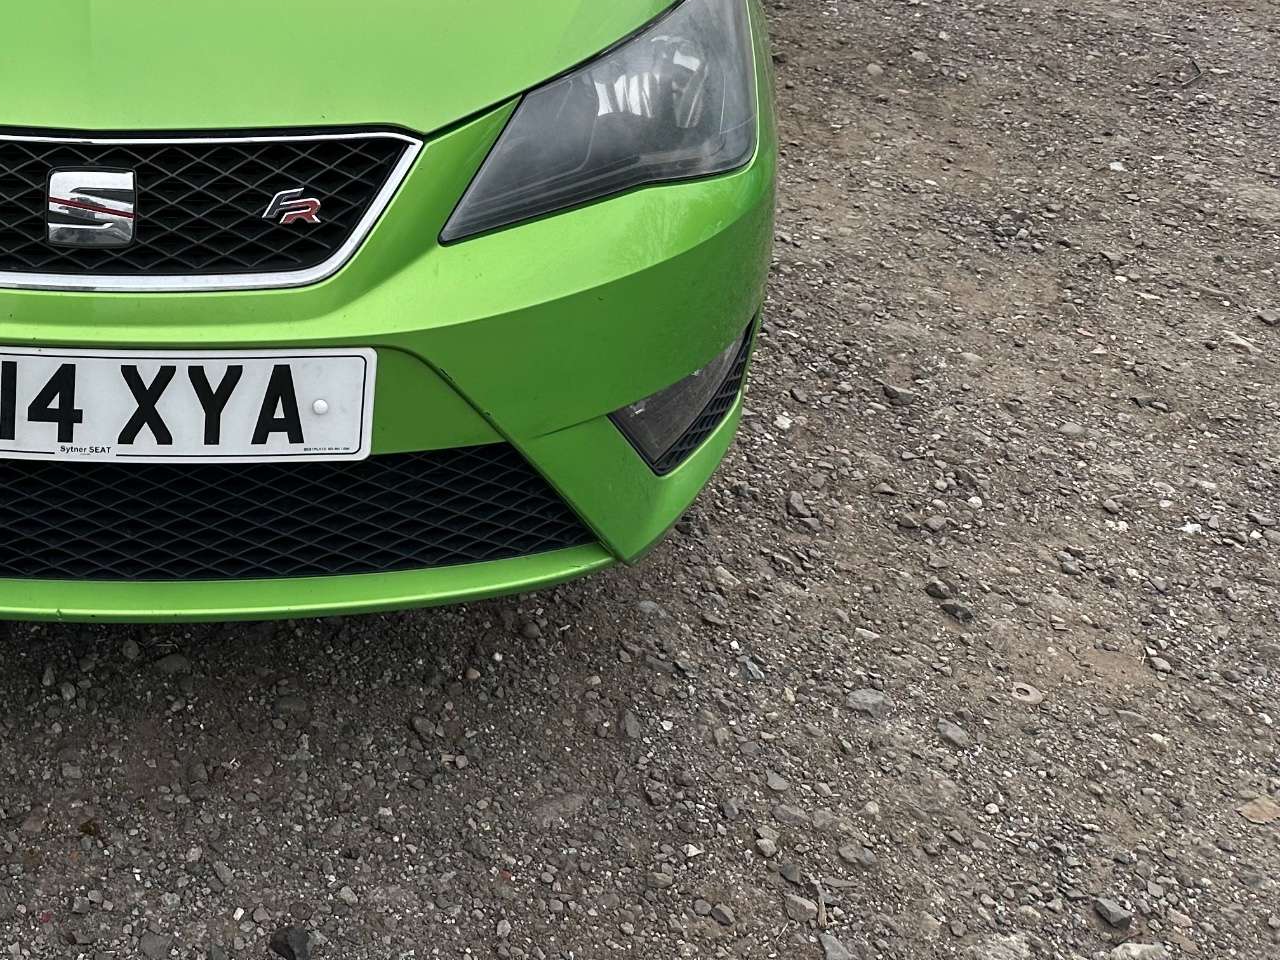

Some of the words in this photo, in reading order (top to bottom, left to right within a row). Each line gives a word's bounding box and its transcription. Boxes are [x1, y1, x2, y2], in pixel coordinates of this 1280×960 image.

[261, 187, 322, 224] FR
[117, 363, 305, 446] XYA
[60, 445, 87, 453] Sytner
